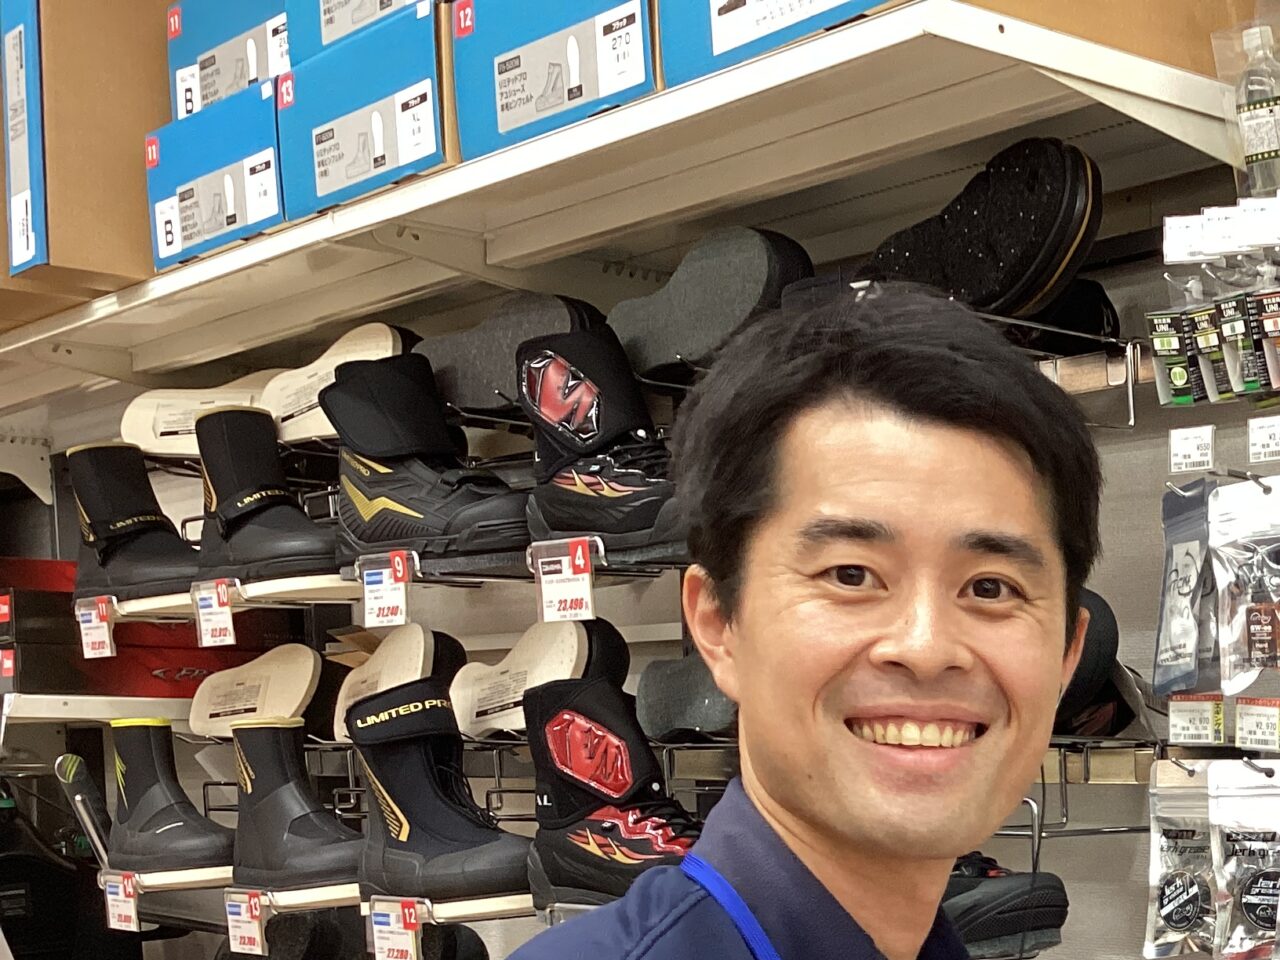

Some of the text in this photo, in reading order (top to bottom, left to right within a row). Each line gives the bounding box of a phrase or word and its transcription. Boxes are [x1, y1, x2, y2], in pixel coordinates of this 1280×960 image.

[459, 7, 473, 29] 12
[280, 80, 293, 104] 13
[147, 144, 157, 162] 11
[574, 545, 586, 570] 4
[395, 559, 405, 579] 9
[218, 584, 228, 603] 10
[557, 598, 584, 613] 23,496
[356, 700, 424, 728] LIMITED
[123, 877, 133, 897] 14
[249, 897, 260, 918] 13
[404, 905, 417, 926] 12
